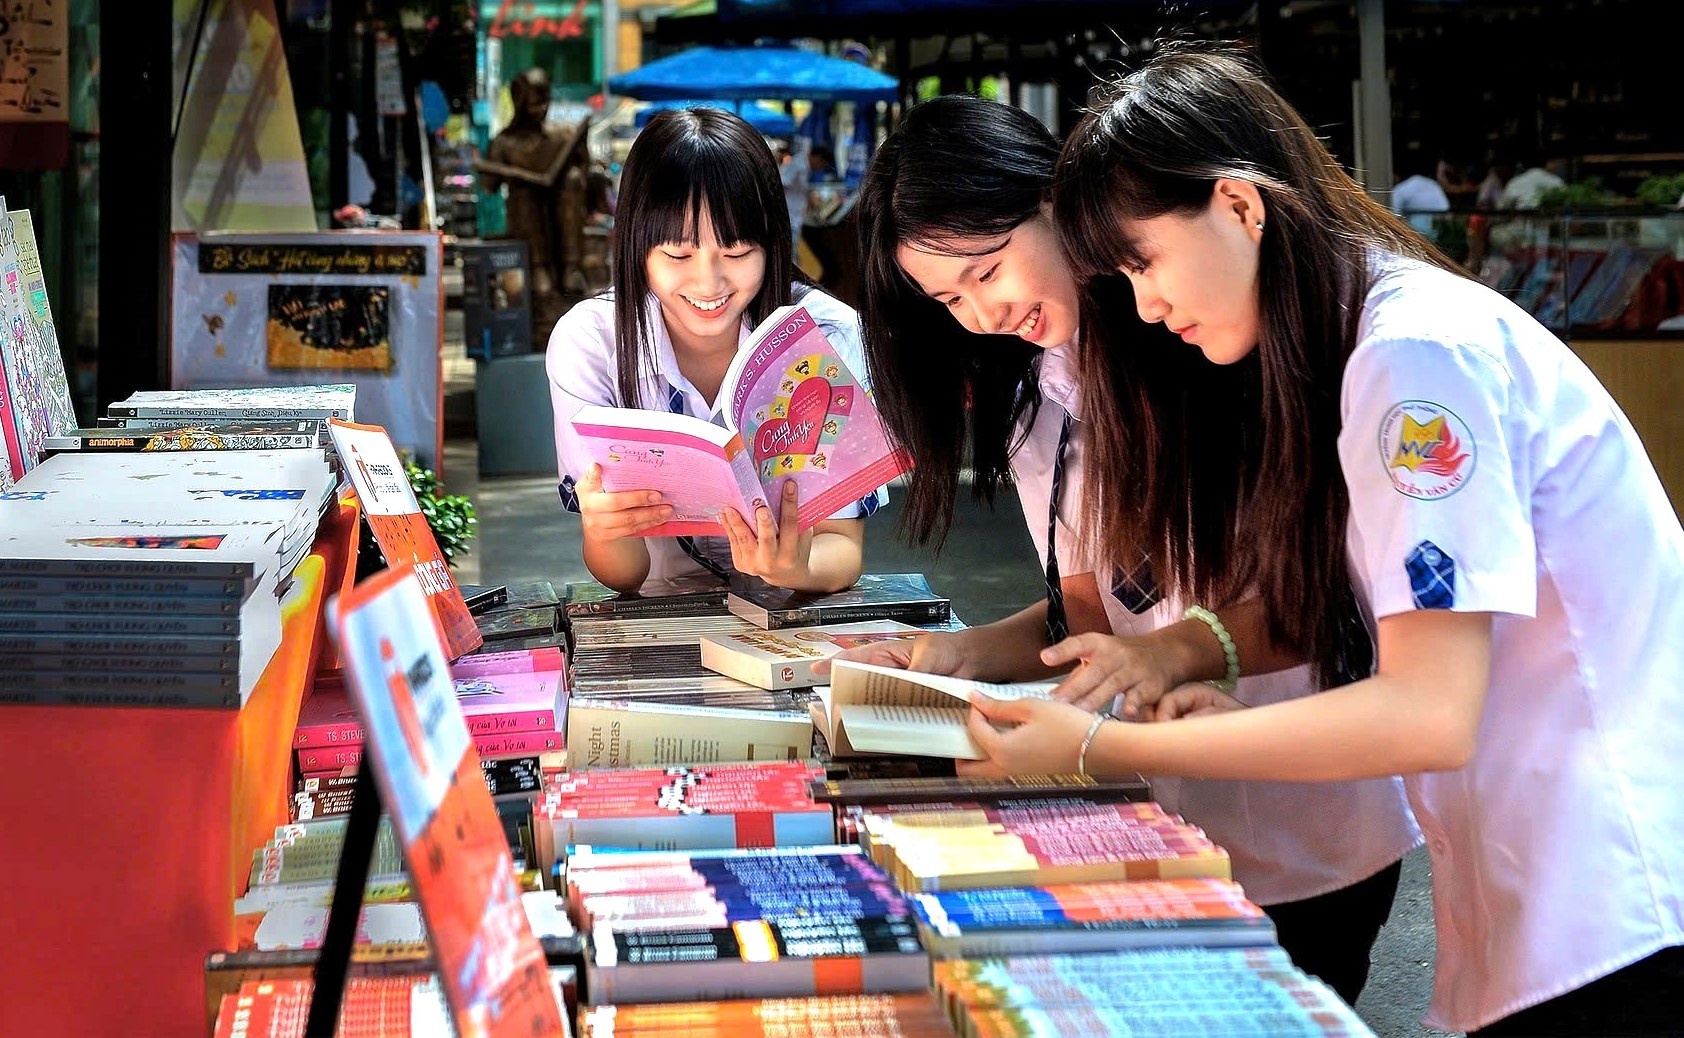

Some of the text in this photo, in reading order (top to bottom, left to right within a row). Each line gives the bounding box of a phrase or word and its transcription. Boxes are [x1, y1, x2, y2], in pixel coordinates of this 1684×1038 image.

[755, 314, 808, 366] HUSSON
[88, 437, 135, 449] animorphia
[327, 731, 340, 742] TS.
[588, 727, 604, 767] Night
